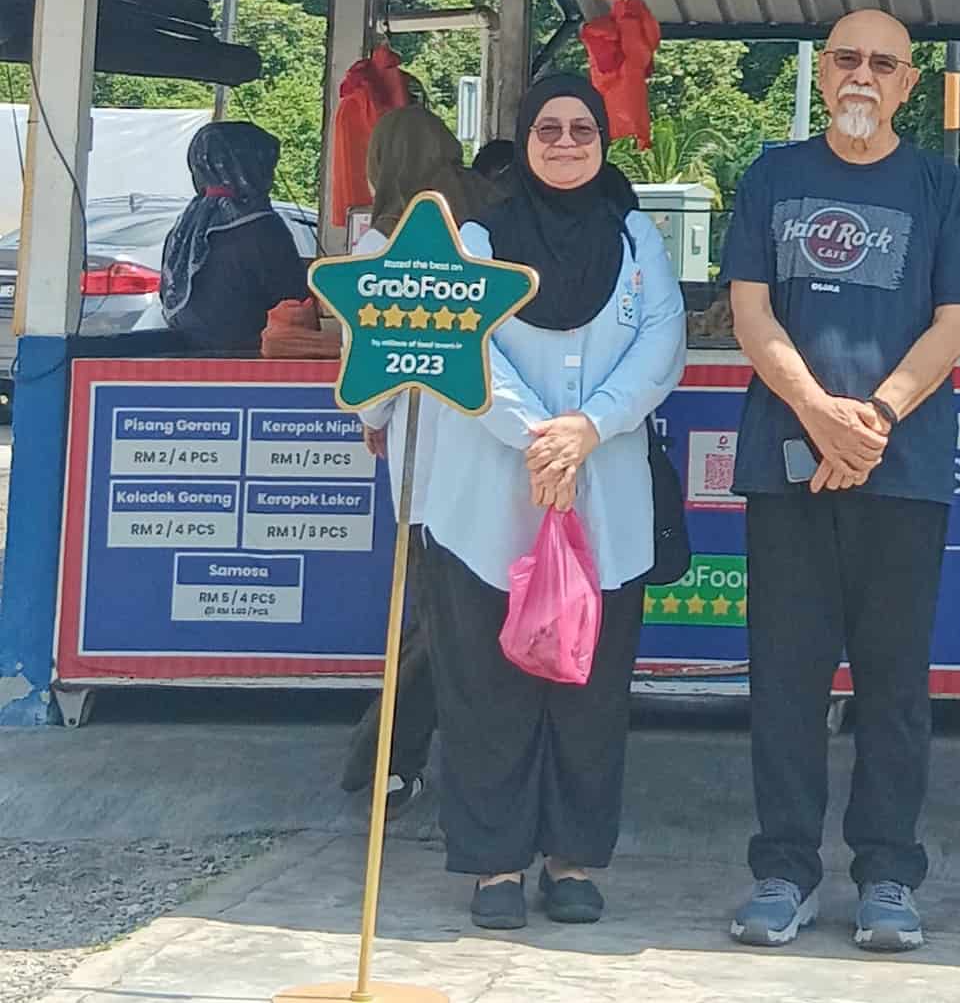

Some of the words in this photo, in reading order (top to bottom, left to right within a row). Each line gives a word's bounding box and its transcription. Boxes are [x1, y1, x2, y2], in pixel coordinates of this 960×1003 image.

[782, 219, 836, 242] Hard
[835, 222, 893, 254] Rock
[817, 247, 849, 262] CAFE
[357, 273, 487, 302] GrabFood
[385, 353, 445, 375] 2023
[124, 418, 174, 435] Pisang
[134, 451, 156, 463] RM
[159, 451, 167, 463] 2
[178, 451, 187, 463] 4
[190, 451, 219, 463] PCS
[271, 453, 293, 465] RM
[323, 453, 352, 465] PCS
[131, 523, 153, 535] RM
[155, 523, 164, 535] 2
[187, 524, 216, 535] PCS
[267, 526, 289, 538] RM
[320, 526, 349, 538] PCS
[208, 564, 269, 577] Samosa
[679, 564, 748, 588] Foo
[199, 592, 219, 603] RM
[239, 592, 248, 603] 4
[251, 593, 277, 605] PCS
